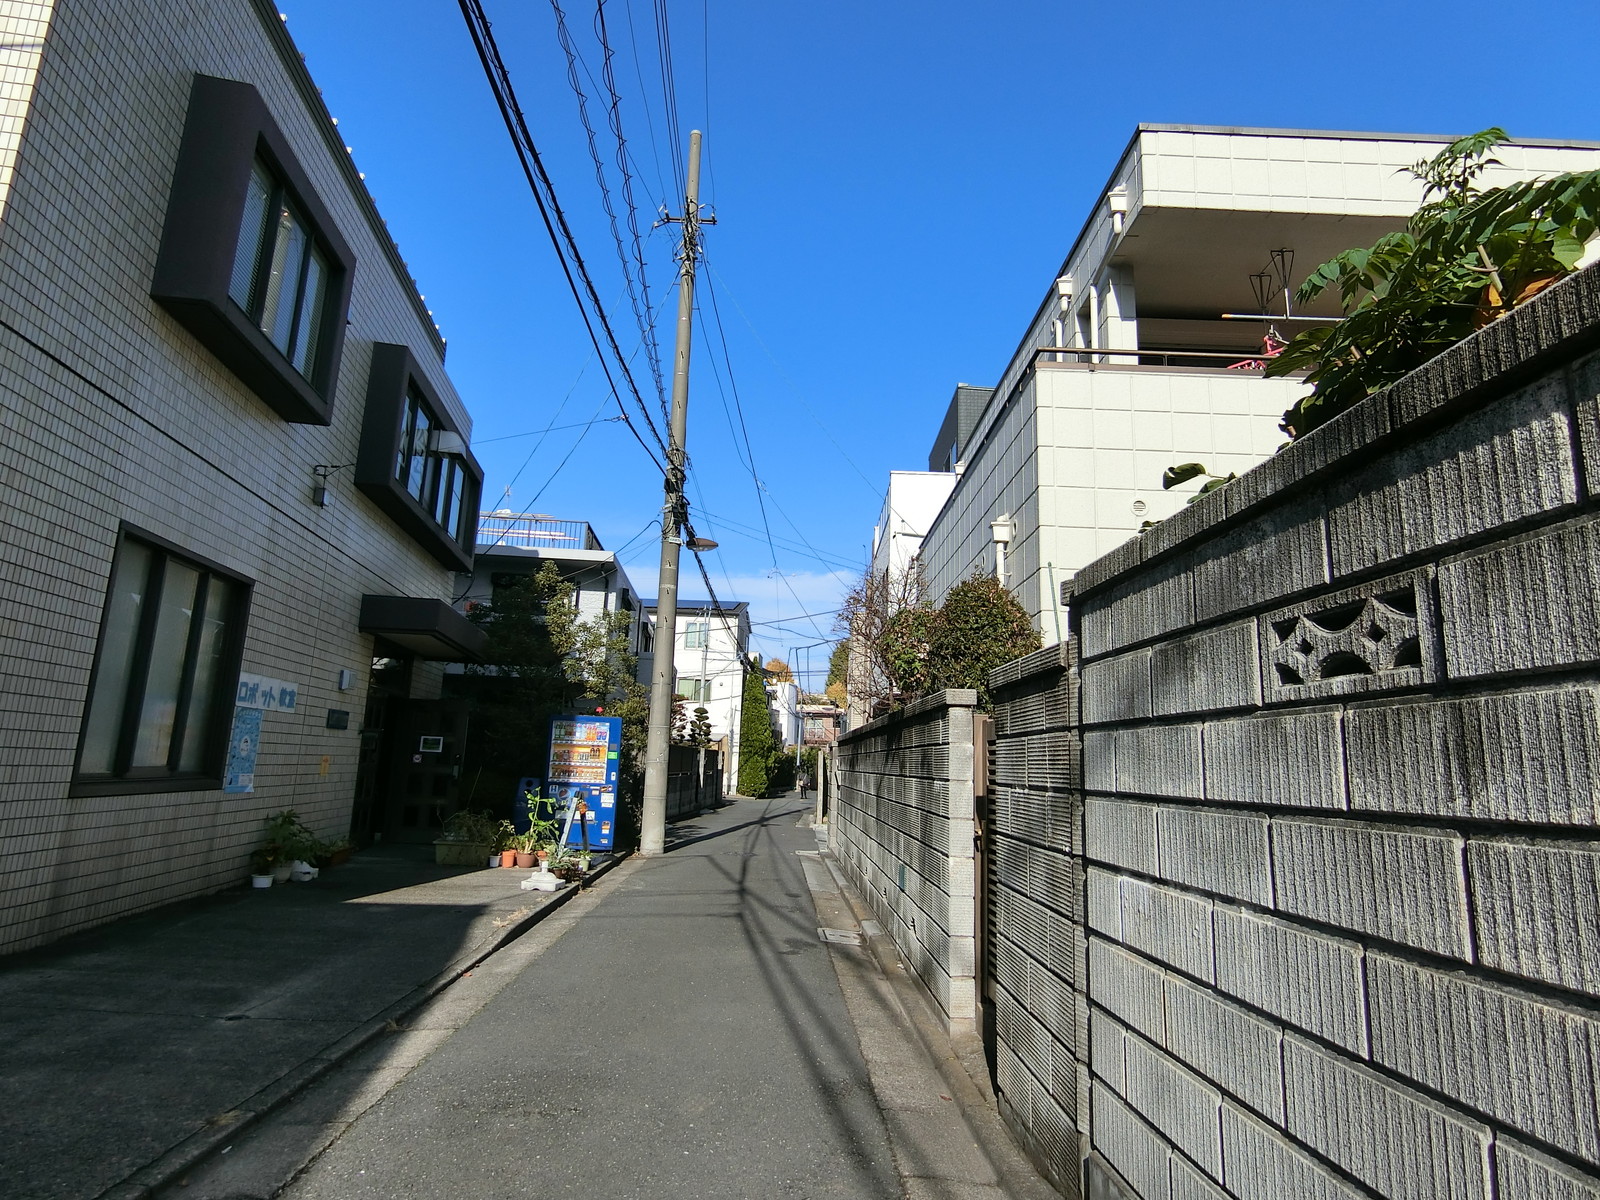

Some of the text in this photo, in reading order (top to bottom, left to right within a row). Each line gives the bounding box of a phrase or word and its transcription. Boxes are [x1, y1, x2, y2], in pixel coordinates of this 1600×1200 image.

[238, 682, 296, 708] ロボット教室
